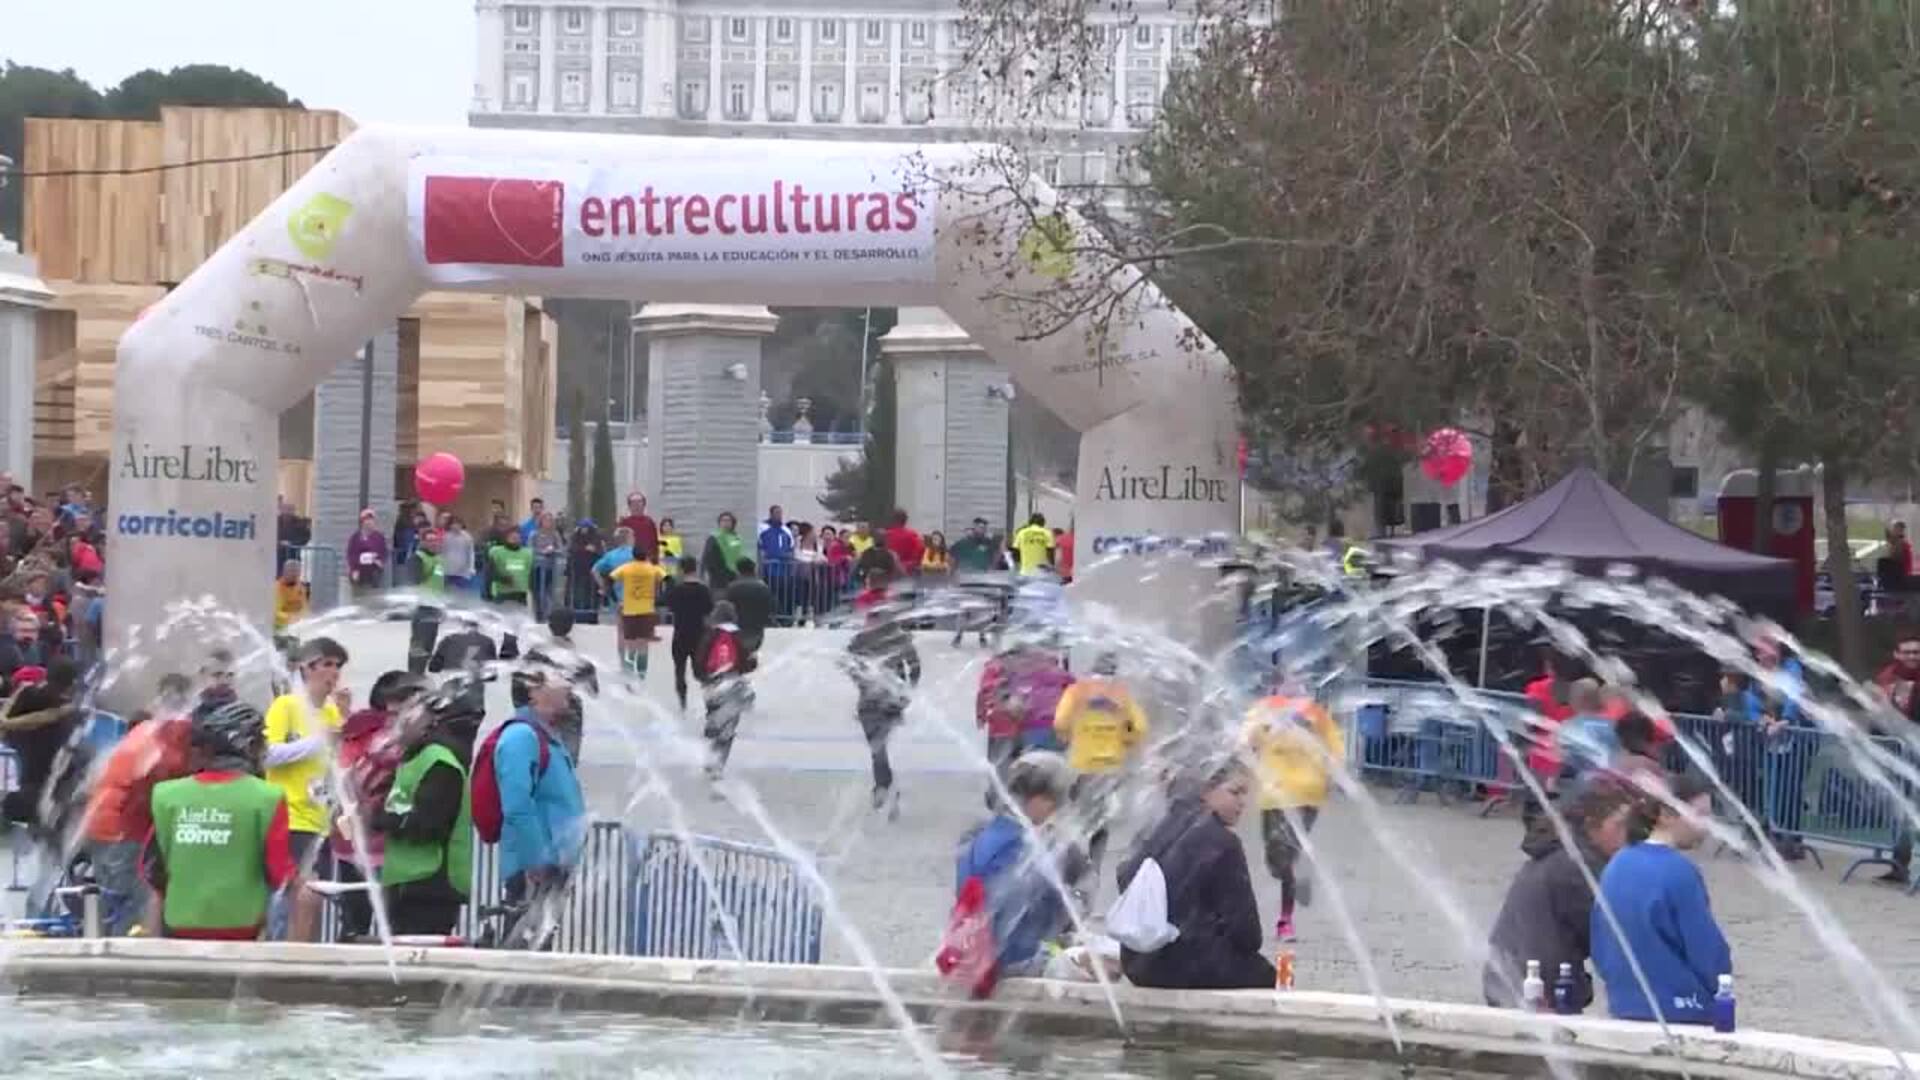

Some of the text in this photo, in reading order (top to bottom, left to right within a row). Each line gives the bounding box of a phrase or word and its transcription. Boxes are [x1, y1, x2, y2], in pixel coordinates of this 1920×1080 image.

[580, 179, 918, 237] entreculturas
[581, 252, 612, 263] ONG
[666, 251, 700, 262] PARA
[703, 250, 720, 262] LA
[722, 248, 799, 262] EDUCACIÓN
[802, 249, 812, 260] Y
[814, 249, 829, 260] EL
[833, 247, 919, 260] DESARROLLO
[119, 443, 258, 483] AireLibre
[1095, 464, 1226, 502] AireLibre
[118, 508, 256, 540] corricolari
